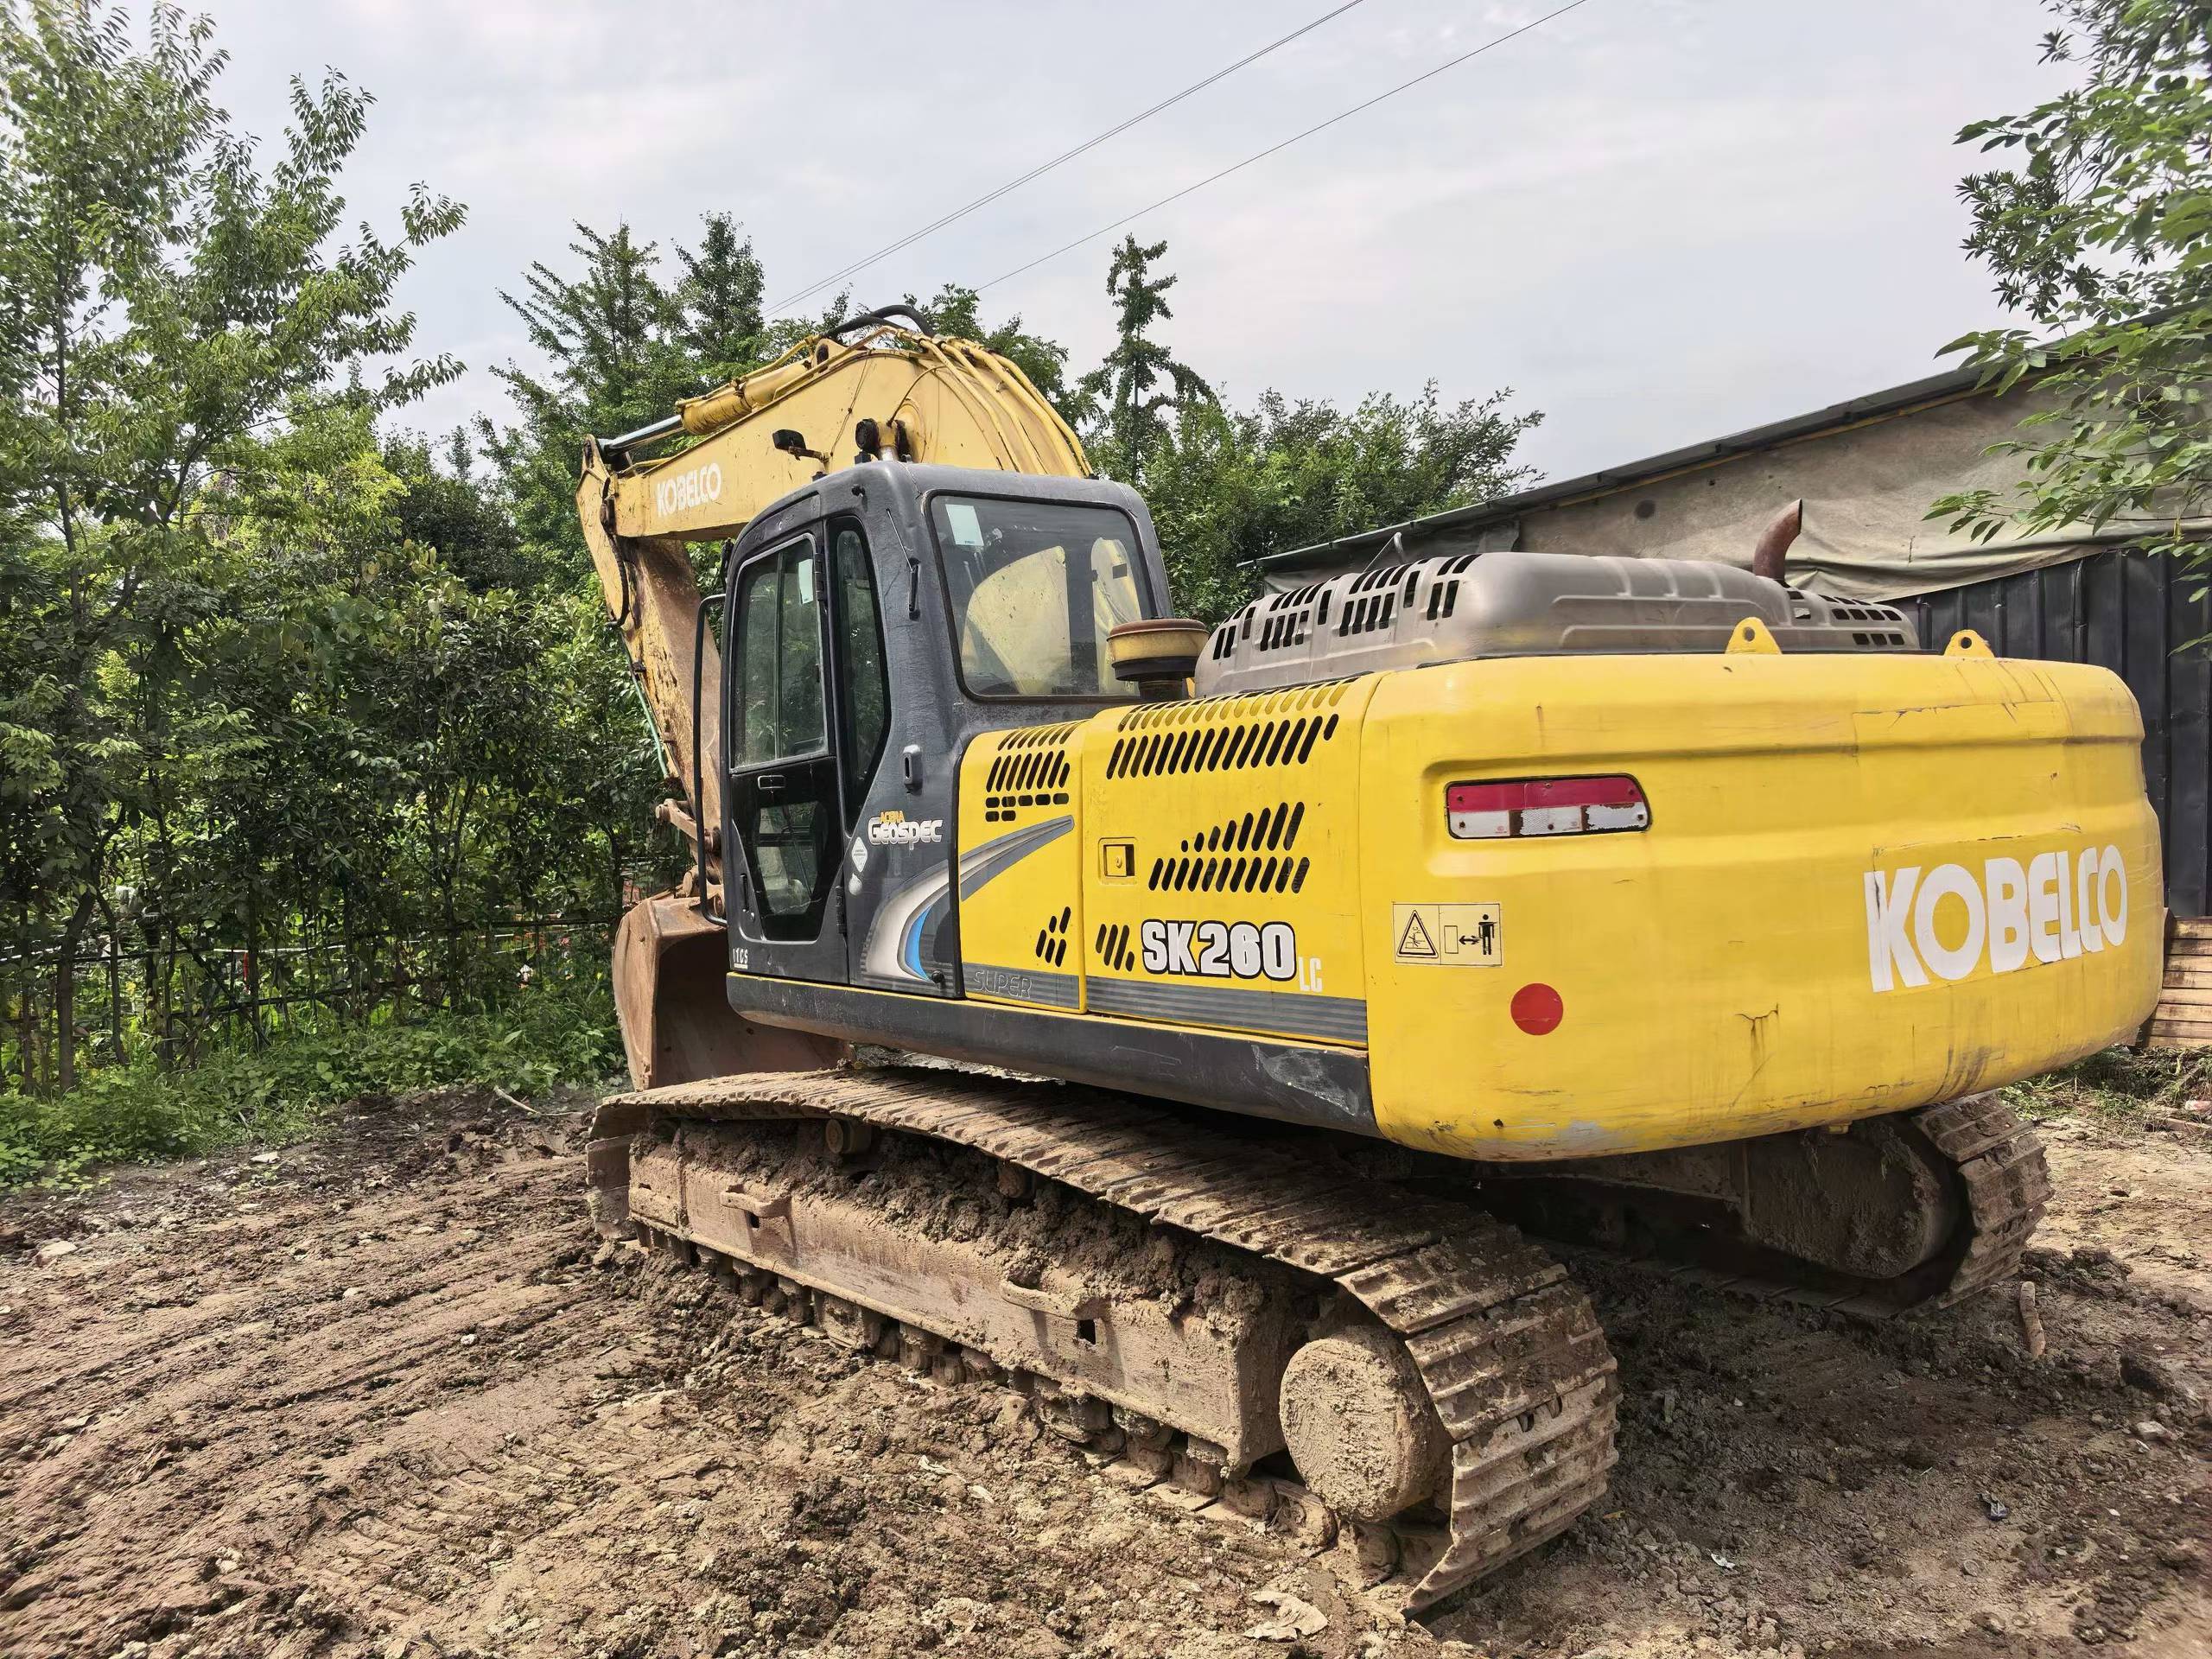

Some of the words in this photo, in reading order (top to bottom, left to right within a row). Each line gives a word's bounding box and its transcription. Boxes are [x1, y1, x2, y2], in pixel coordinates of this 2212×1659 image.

[657, 462, 721, 517] KOBELCO
[1864, 844, 2128, 993] KOBELCO
[974, 969, 1033, 999] SUPER
[1141, 918, 1298, 982] SK260
[1299, 956, 1323, 993] LC
